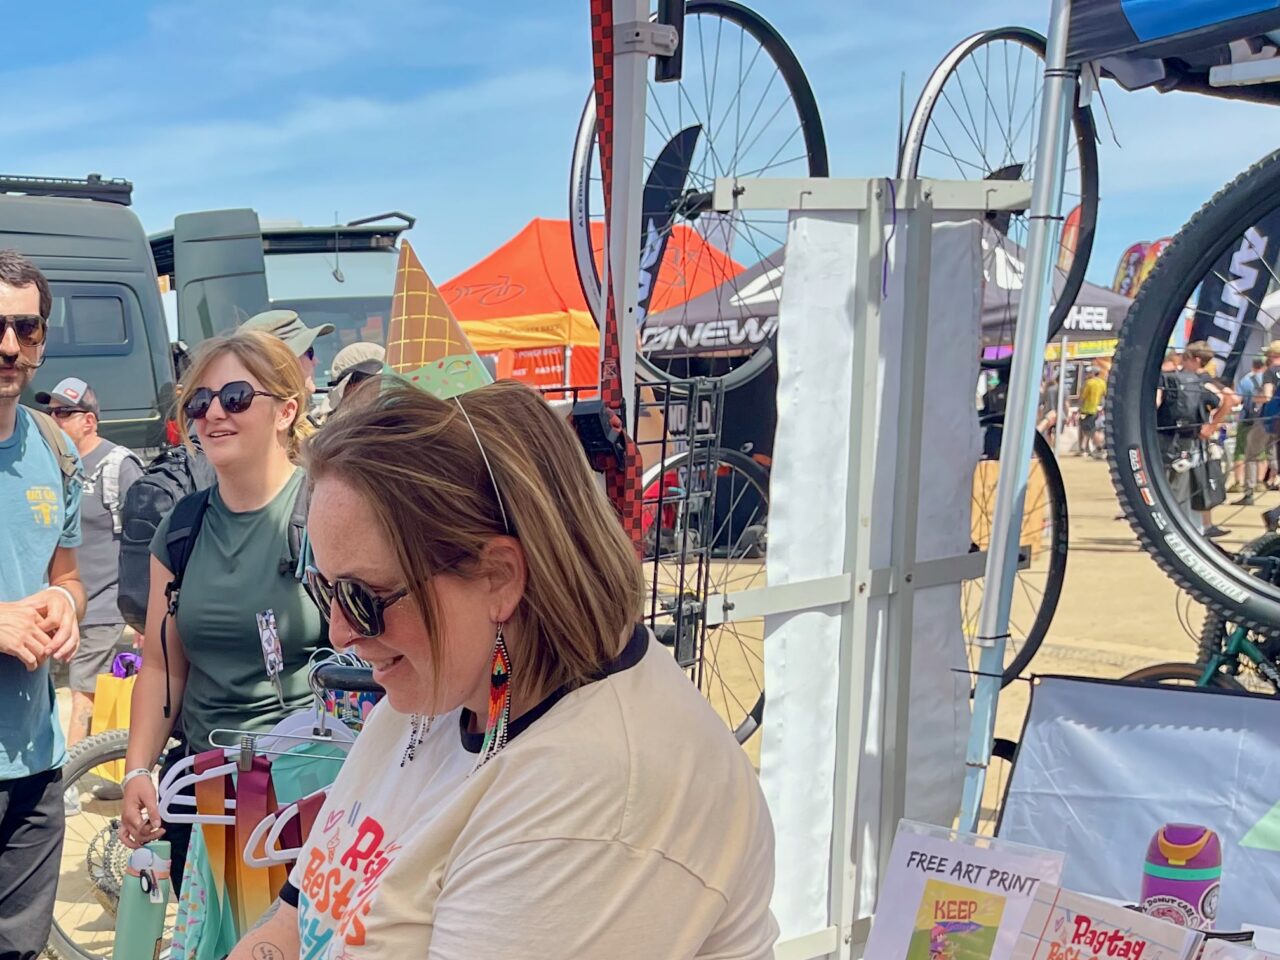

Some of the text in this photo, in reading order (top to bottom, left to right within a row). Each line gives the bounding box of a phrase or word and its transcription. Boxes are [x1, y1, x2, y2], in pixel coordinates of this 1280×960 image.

[1207, 226, 1268, 378] ANTI
[907, 851, 1040, 896] FREE ART PRINT
[934, 900, 978, 920] KEEP
